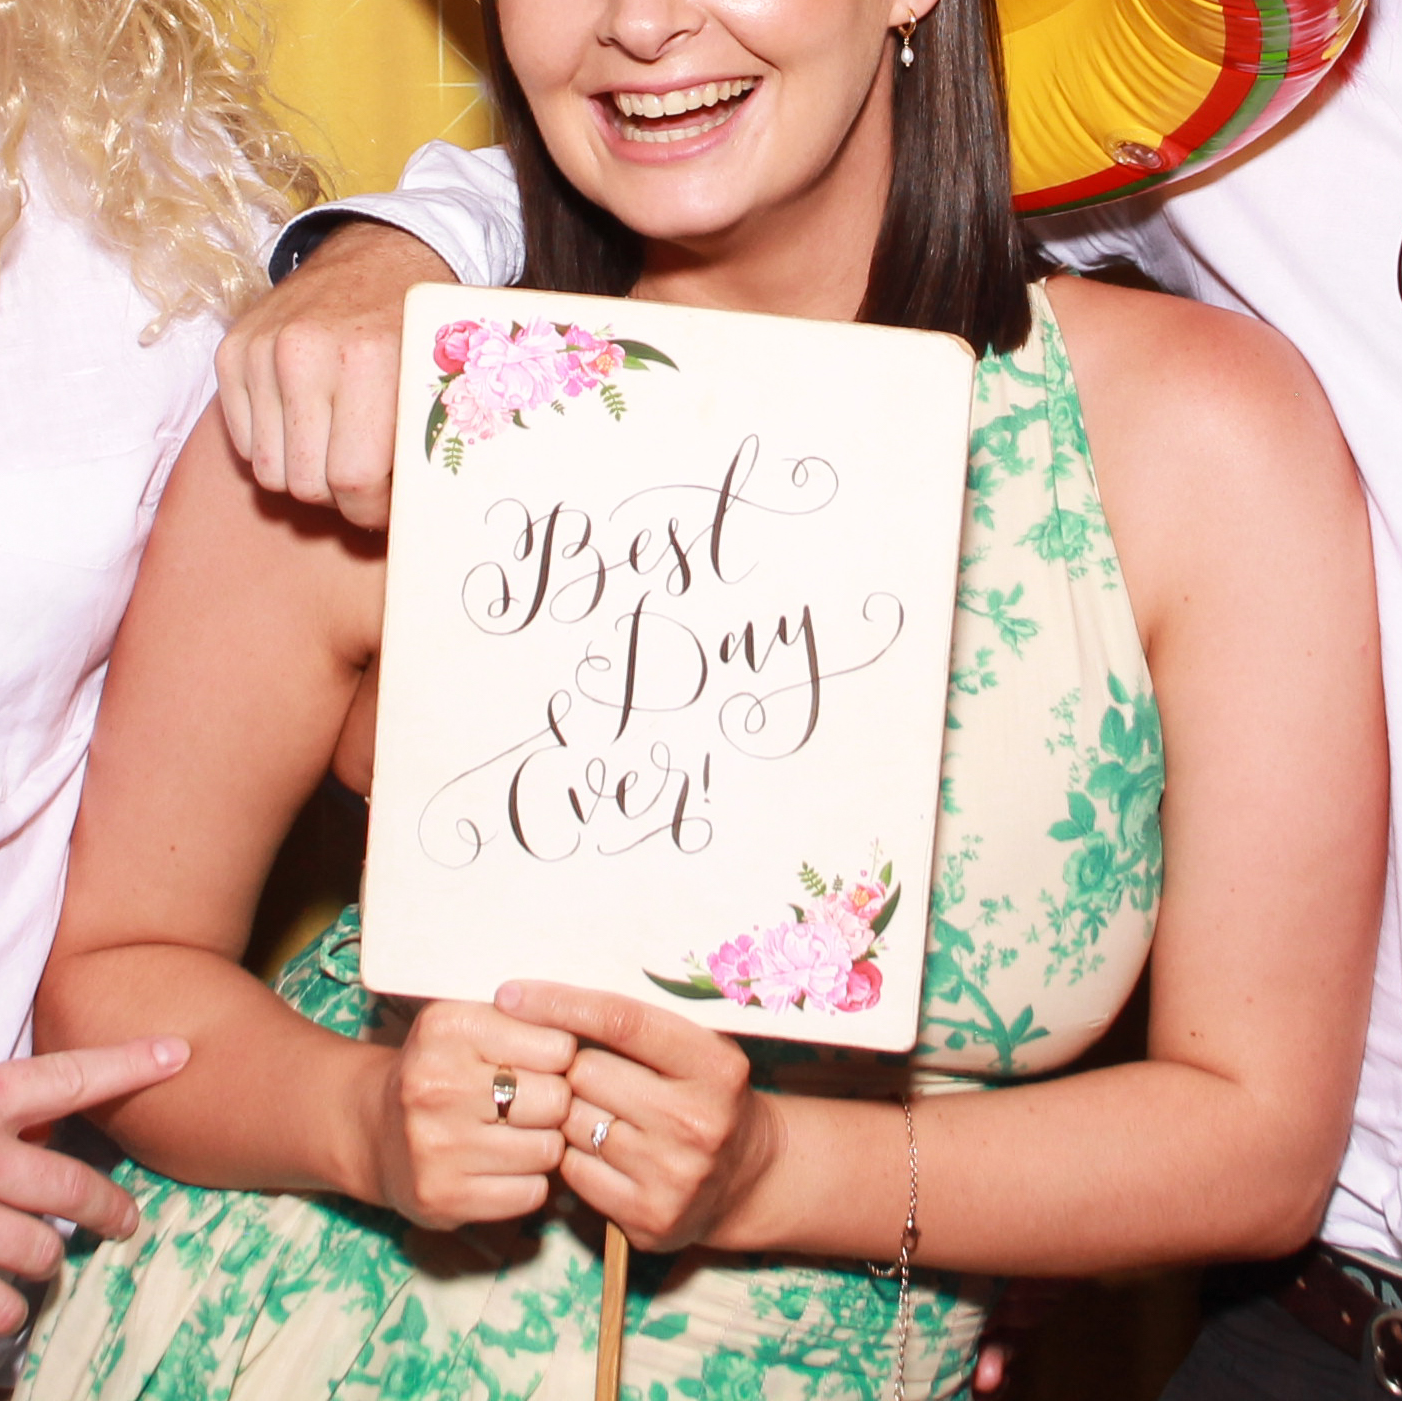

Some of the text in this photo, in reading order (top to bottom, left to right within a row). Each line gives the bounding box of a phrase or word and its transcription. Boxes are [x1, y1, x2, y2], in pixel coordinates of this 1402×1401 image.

[461, 434, 839, 636] Best
[575, 590, 904, 760] Day
[418, 689, 713, 870] Ever!
